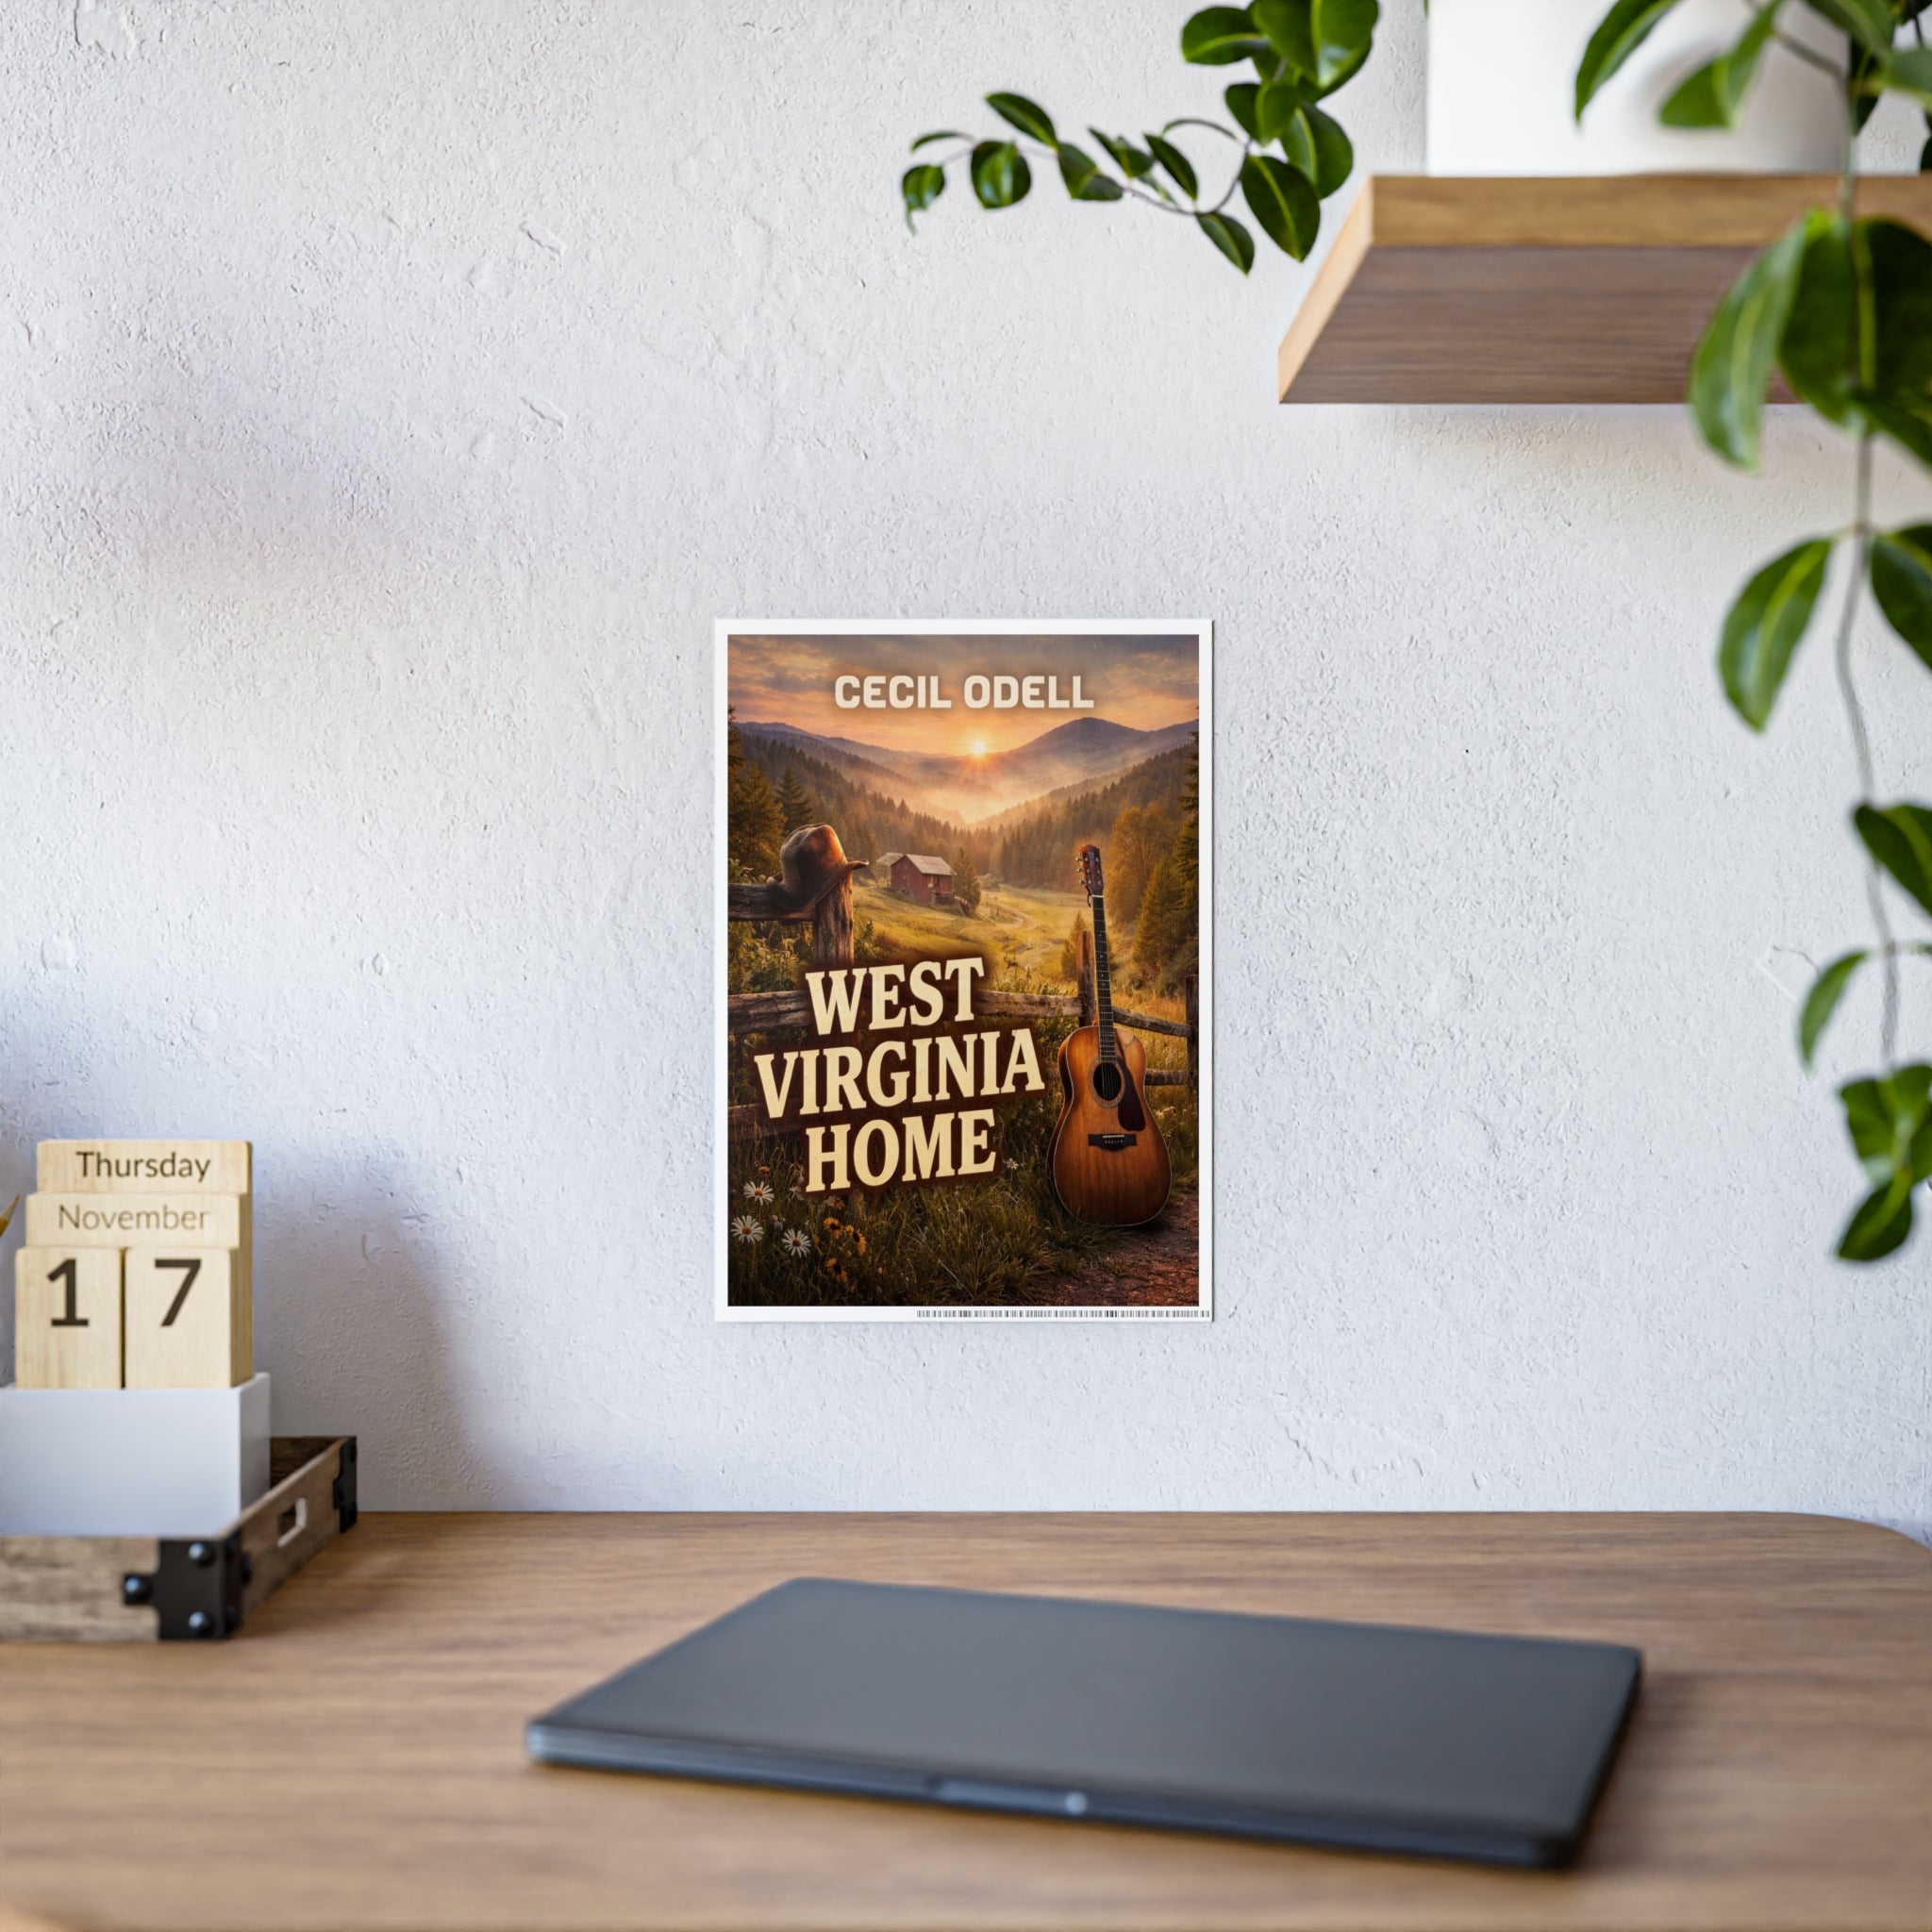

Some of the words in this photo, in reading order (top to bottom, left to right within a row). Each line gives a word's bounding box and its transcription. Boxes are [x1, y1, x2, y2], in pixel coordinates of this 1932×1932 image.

[834, 675, 952, 709] CECIL
[963, 675, 1095, 709] ODELL
[805, 957, 986, 1036] WEST
[754, 1027, 1045, 1119] VIRGINIA
[75, 1151, 212, 1182] Thursday
[805, 1108, 997, 1193] HOME
[58, 1204, 210, 1231] November
